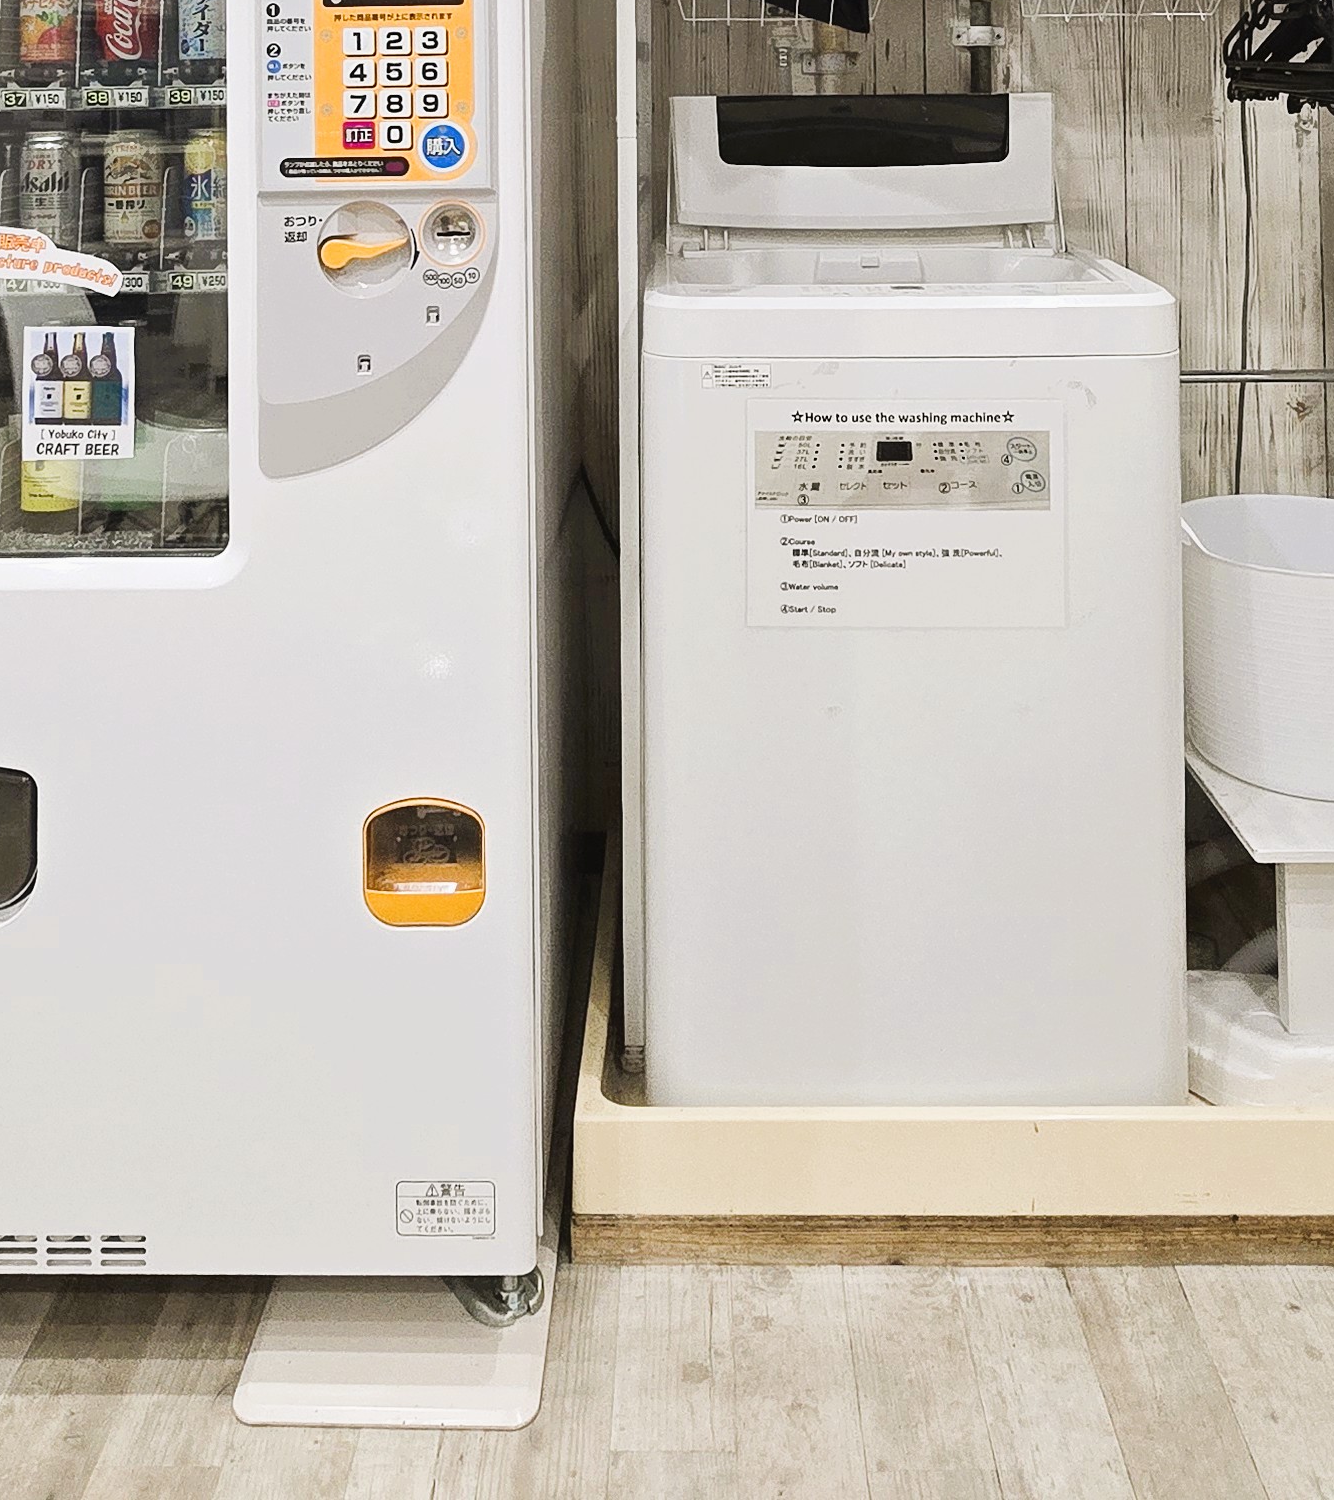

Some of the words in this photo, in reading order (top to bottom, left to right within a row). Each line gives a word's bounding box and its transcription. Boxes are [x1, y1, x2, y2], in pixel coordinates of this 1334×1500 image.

[353, 32, 362, 50] 1
[386, 31, 403, 50] 2
[422, 31, 439, 49] 3
[349, 63, 367, 82] 4
[386, 63, 403, 81] 5
[421, 62, 438, 80] 6
[34, 93, 59, 106] ¥150
[200, 89, 224, 102] ¥150
[350, 95, 367, 114] 7
[386, 95, 404, 113] 8
[422, 94, 439, 112] 9
[345, 127, 373, 143] 訂正
[386, 126, 404, 145] 0
[426, 138, 461, 156] 購入
[284, 231, 308, 243] 返却
[44, 261, 117, 288] products!
[202, 274, 226, 287] ¥250
[805, 412, 832, 423] How
[835, 413, 848, 424] to
[851, 414, 872, 424] use
[875, 412, 895, 424] the
[898, 412, 947, 426] washing
[950, 412, 1001, 424] machine
[48, 429, 84, 440] Yobuko
[87, 429, 108, 440] City
[36, 443, 80, 456] CRAFT
[85, 443, 120, 456] BEER
[818, 605, 837, 614] Stop
[440, 1184, 466, 1197] 警告
